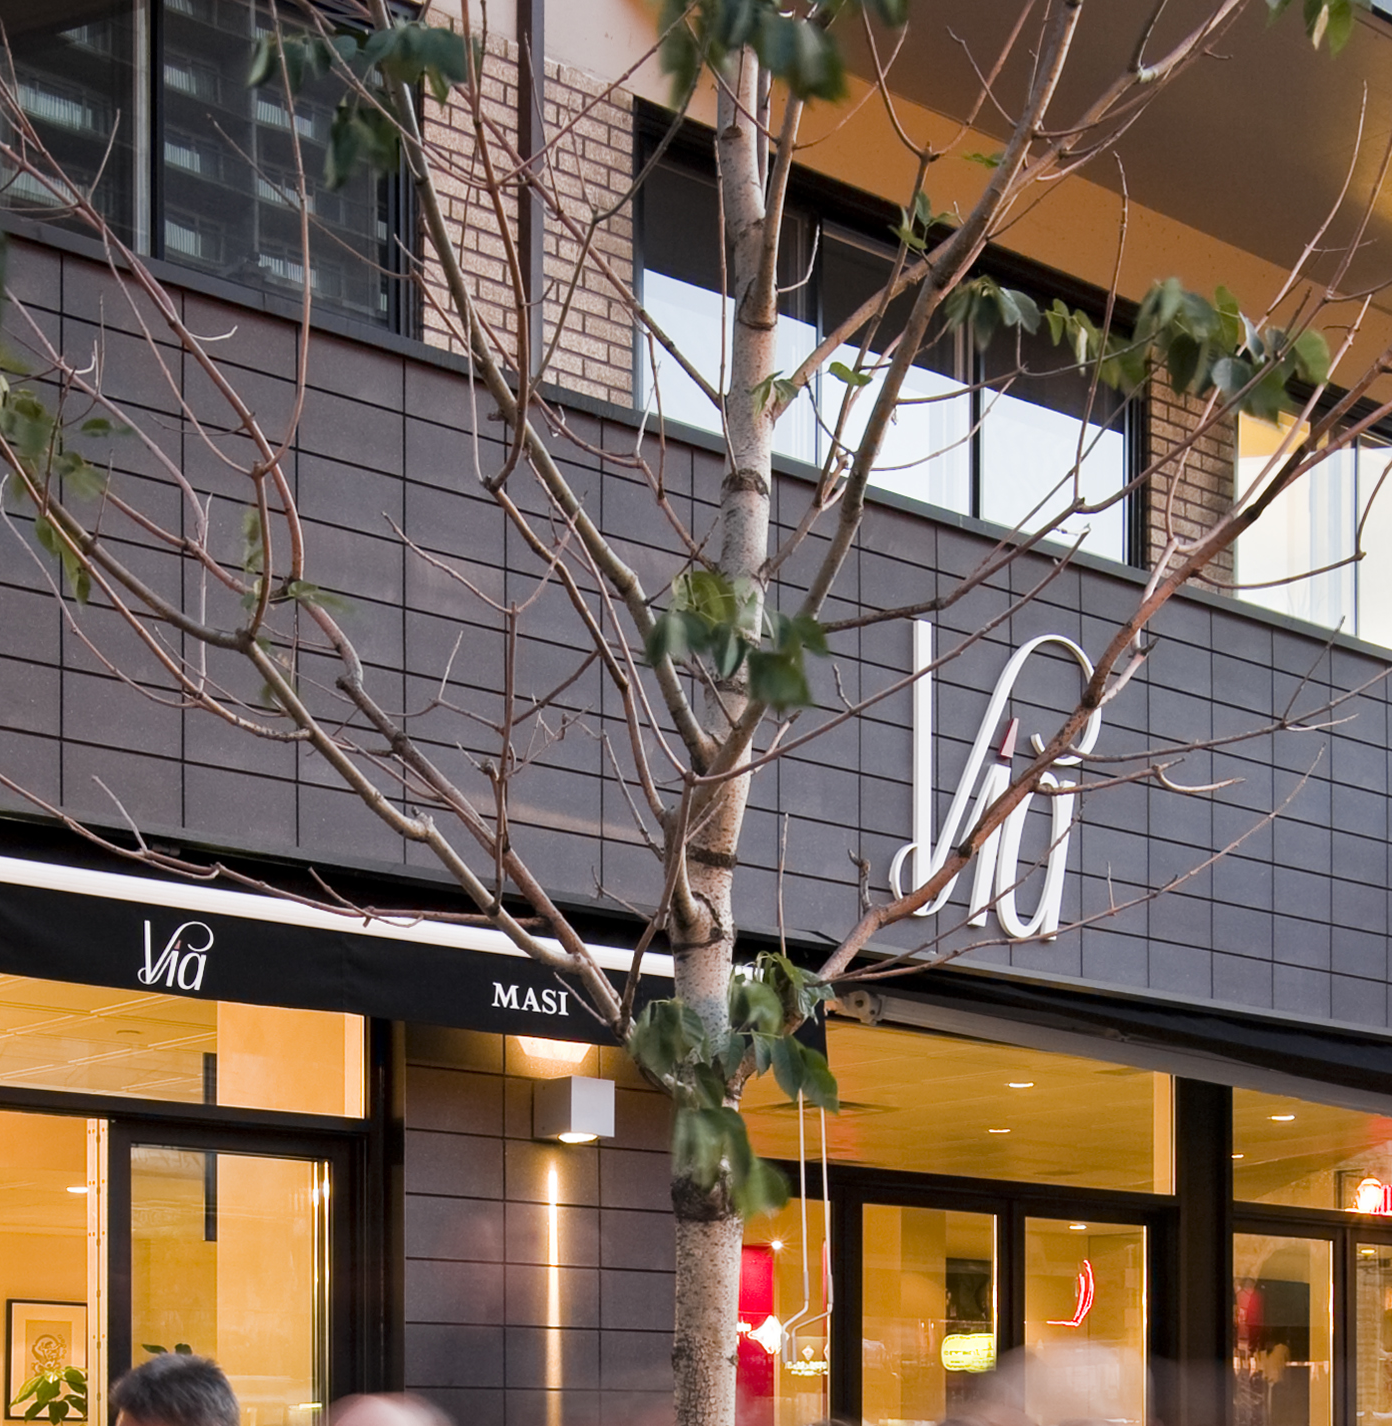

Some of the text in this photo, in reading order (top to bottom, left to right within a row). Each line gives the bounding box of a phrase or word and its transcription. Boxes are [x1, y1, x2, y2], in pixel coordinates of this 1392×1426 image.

[889, 619, 1101, 941] Via
[137, 919, 214, 991] Via
[491, 981, 569, 1016] MASI
